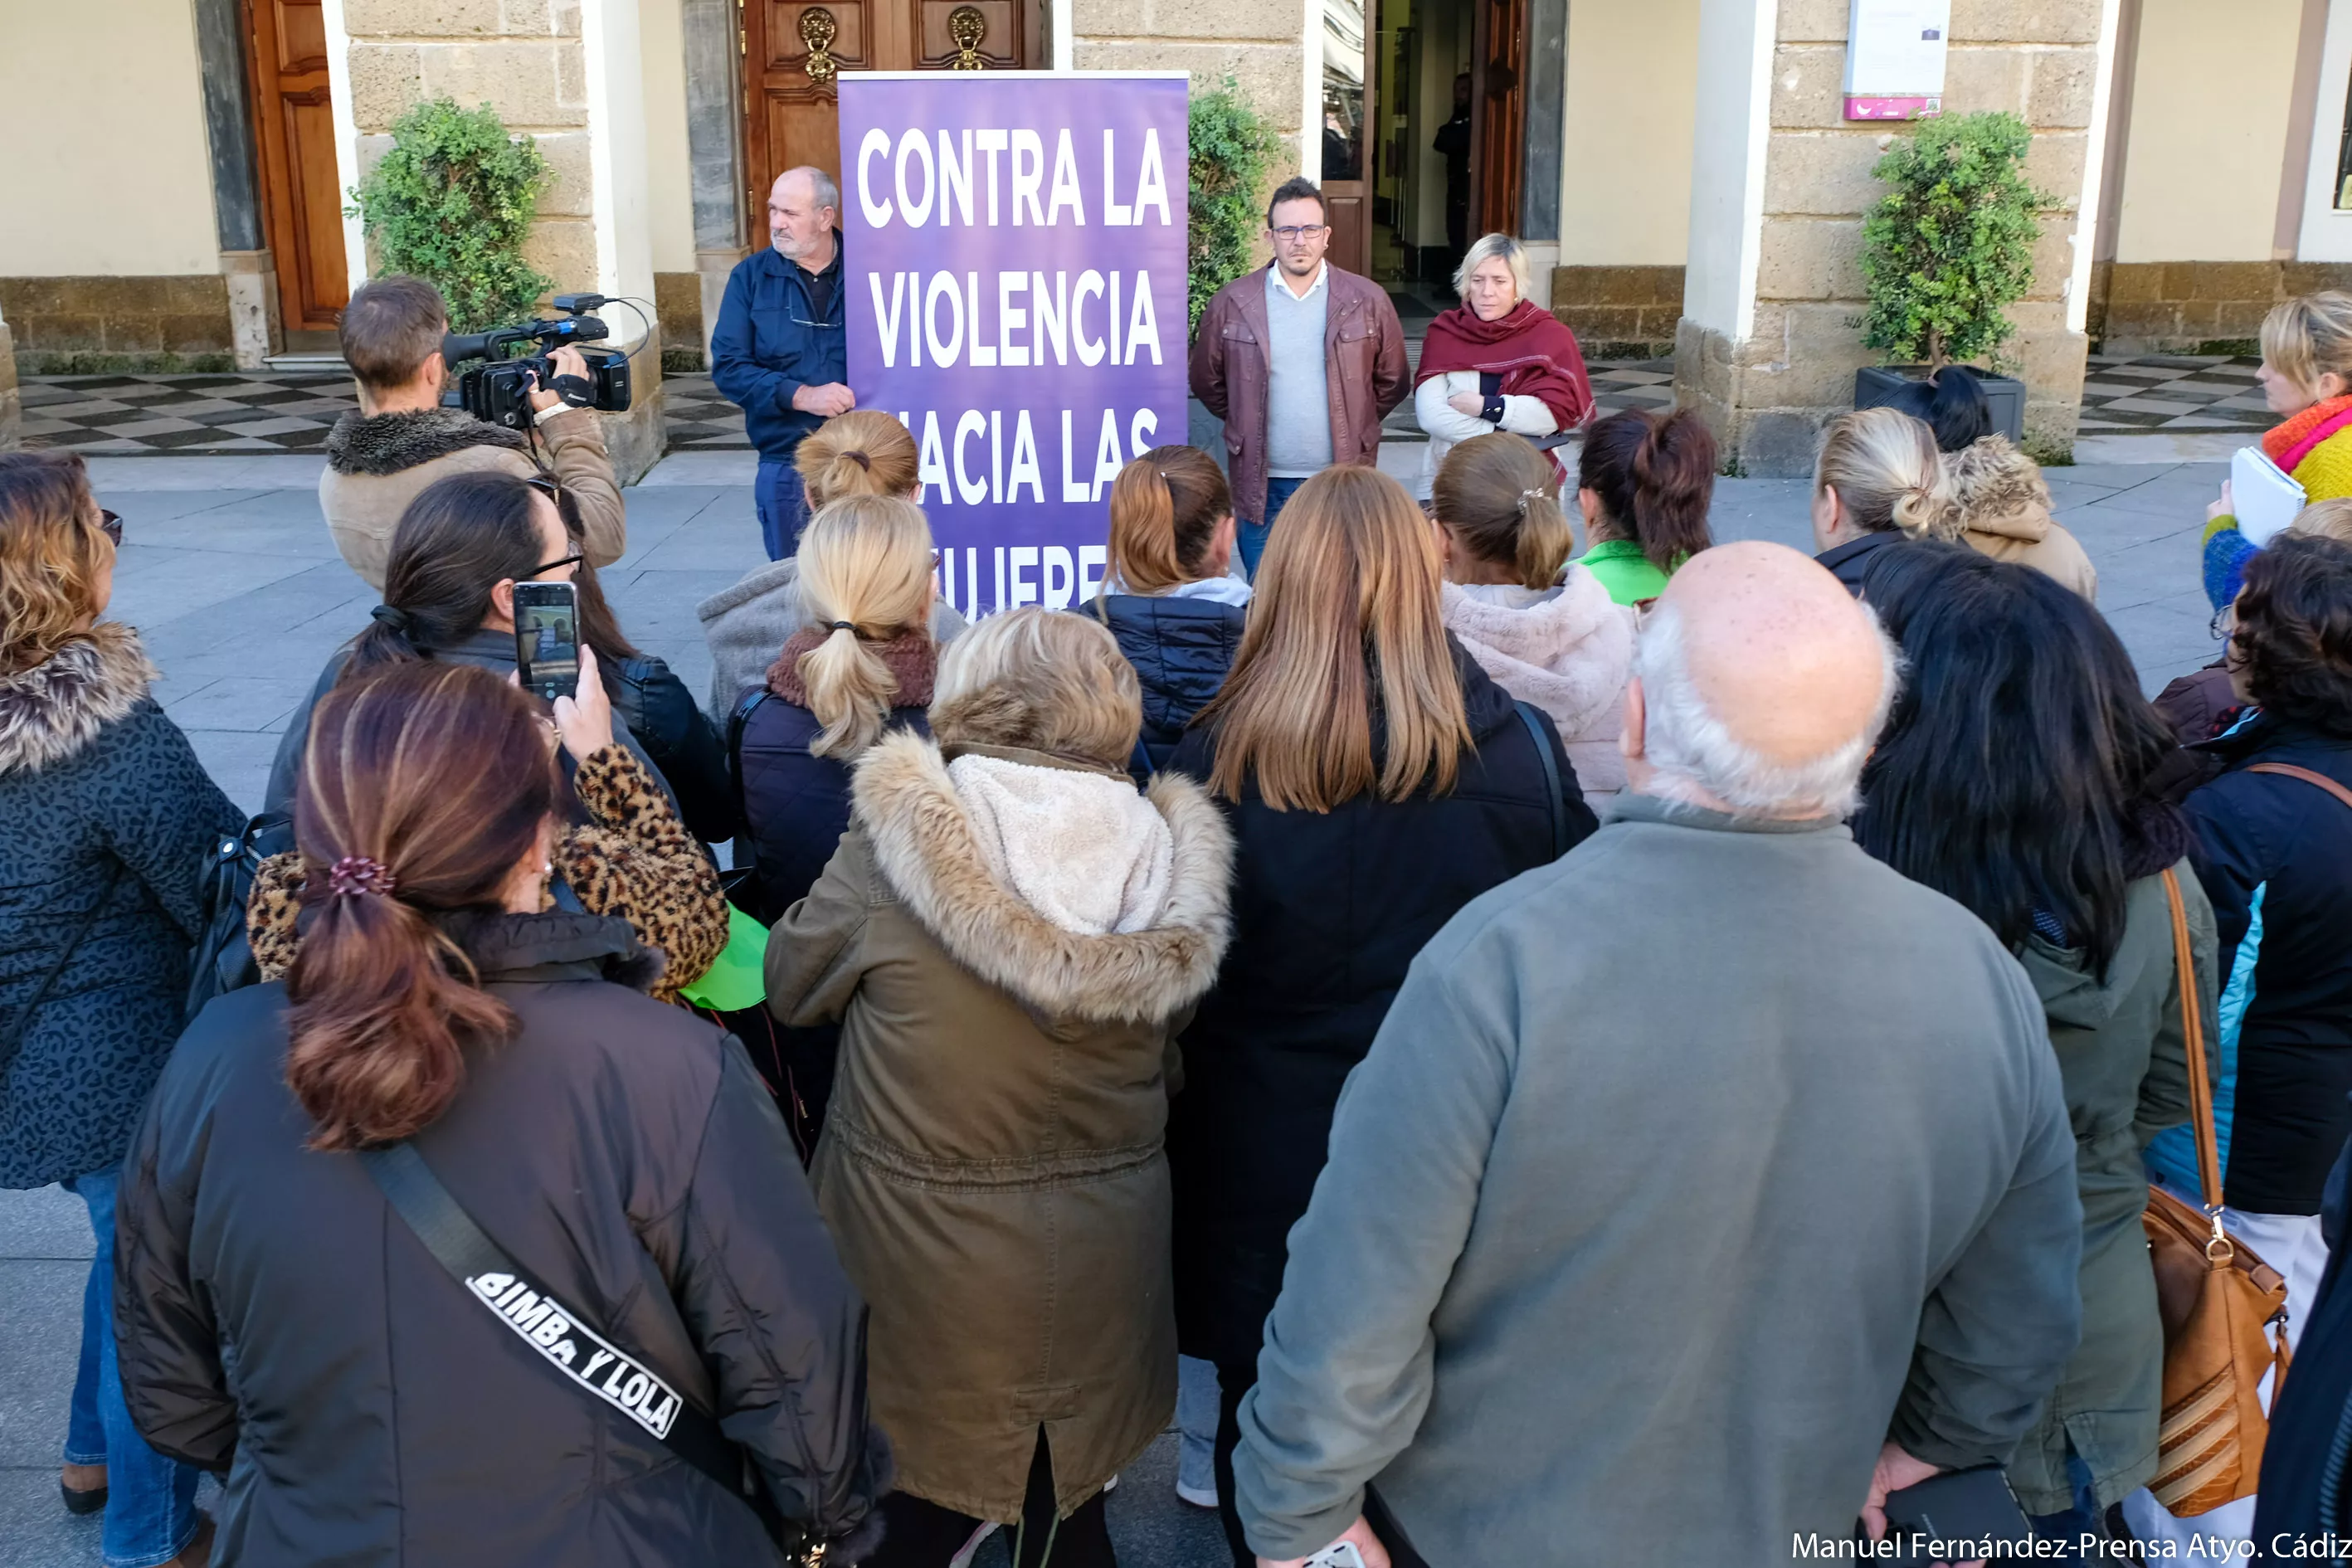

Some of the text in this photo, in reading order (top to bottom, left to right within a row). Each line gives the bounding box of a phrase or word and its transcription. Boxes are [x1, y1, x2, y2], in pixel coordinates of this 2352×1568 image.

[858, 128, 1171, 228] CONTRA LA
[869, 270, 1162, 368] VIOLENCIA
[899, 408, 1045, 505] ACIA
[931, 545, 1108, 624] UJERE
[474, 1273, 674, 1432] BIMBA Y LOLA
